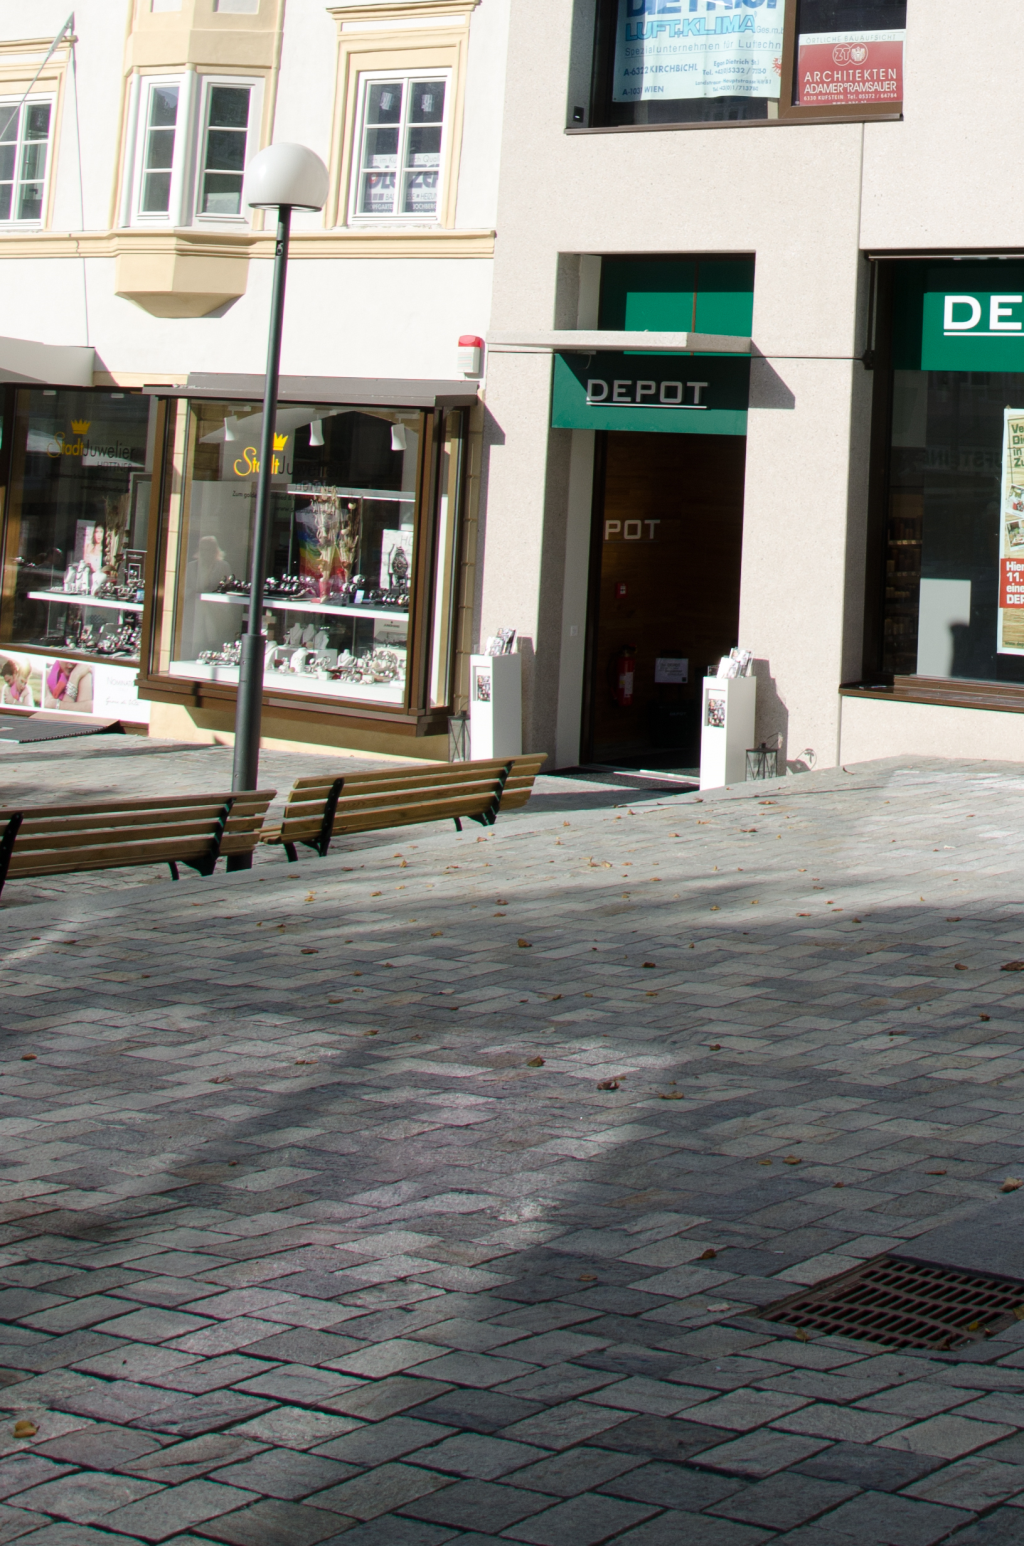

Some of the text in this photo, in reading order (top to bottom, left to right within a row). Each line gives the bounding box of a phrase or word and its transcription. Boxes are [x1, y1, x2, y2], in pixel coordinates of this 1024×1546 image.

[805, 33, 896, 44] ÖRTLICHE BAUAUFSICHT
[625, 42, 720, 57] Spezialunternehmen
[649, 63, 698, 73] KIRCHBICHL
[804, 68, 897, 83] ARCHITEKTEN
[643, 85, 665, 94] WIEN
[587, 378, 710, 405] DEPOT
[1013, 445, 1022, 455] in
[1006, 572, 1023, 583] 11.
